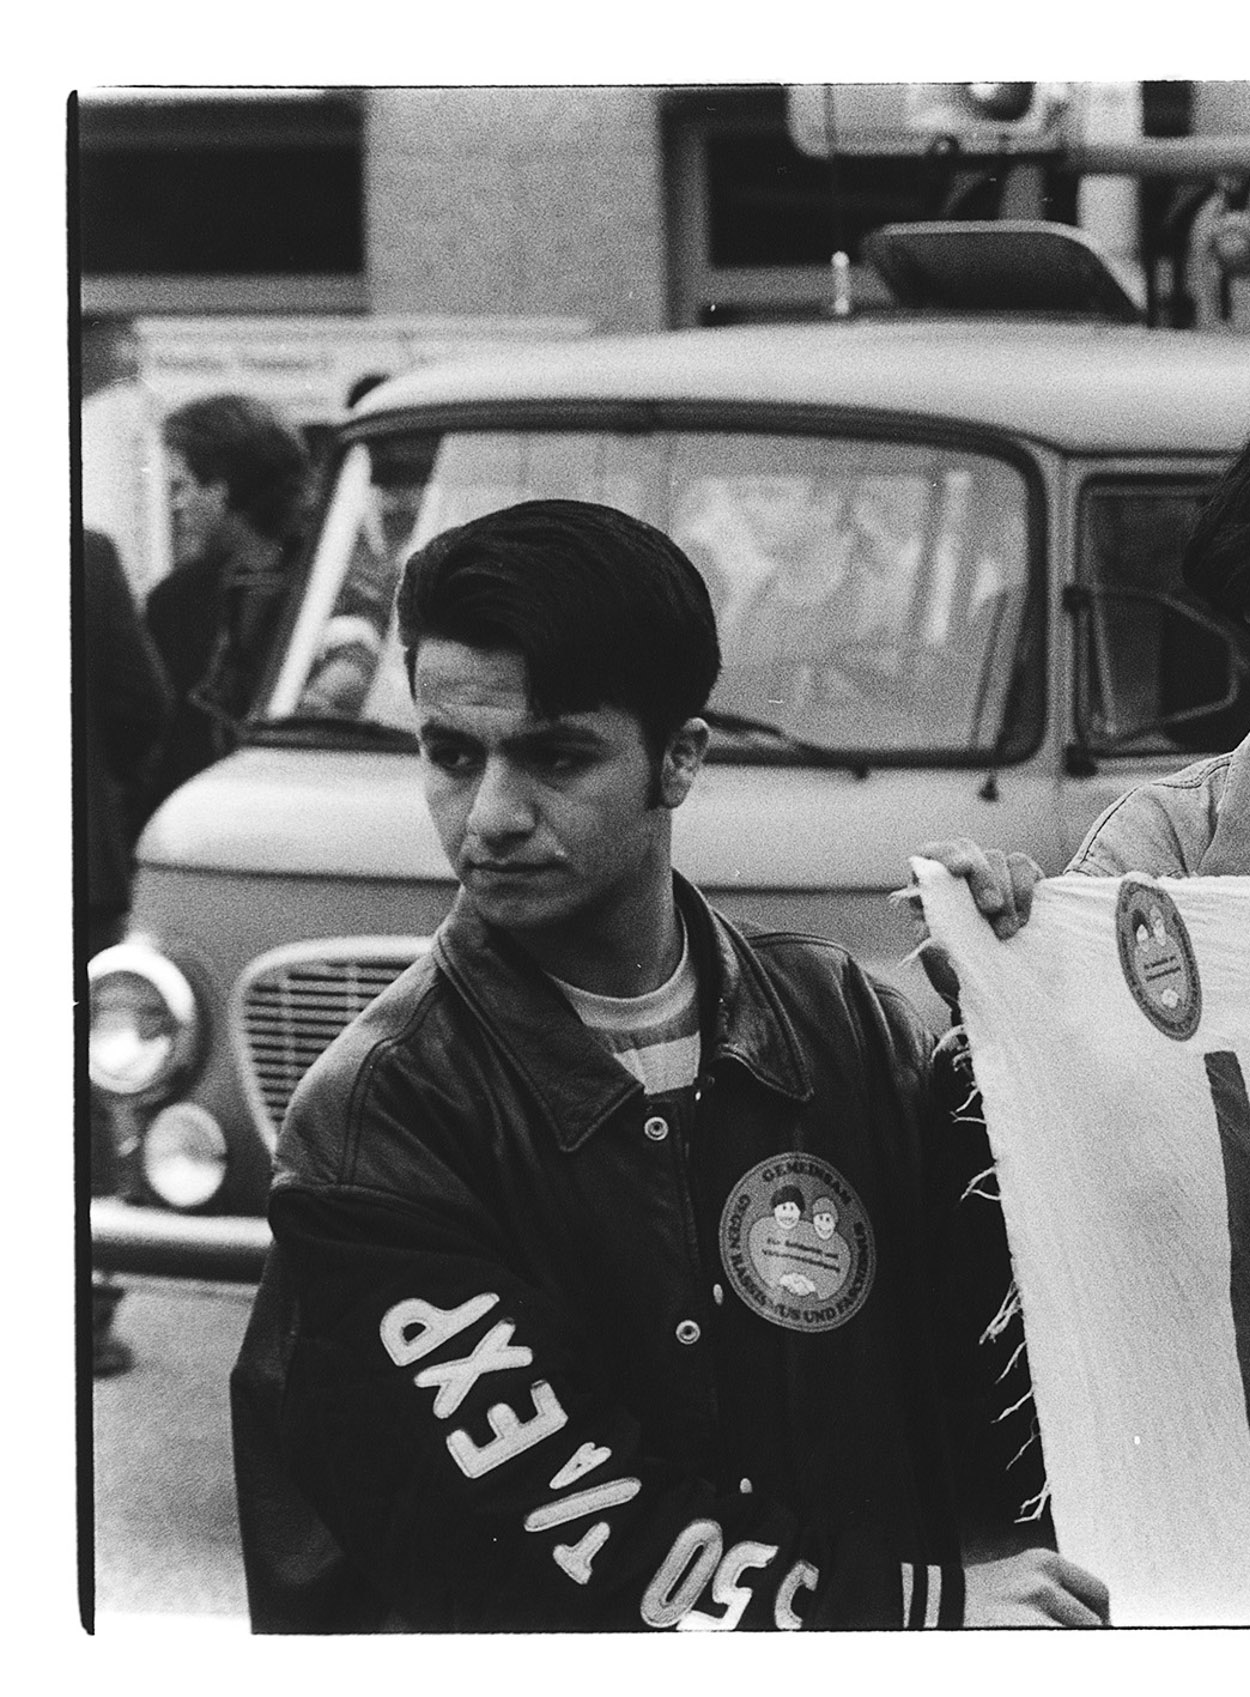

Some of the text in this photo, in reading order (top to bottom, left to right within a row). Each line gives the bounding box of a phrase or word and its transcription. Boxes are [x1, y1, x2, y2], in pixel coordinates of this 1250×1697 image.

[762, 1161, 853, 1205] GEMEINSAM
[729, 1194, 750, 1249] GEGEN
[803, 1307, 836, 1323] UND
[379, 1292, 569, 1479] EXP
